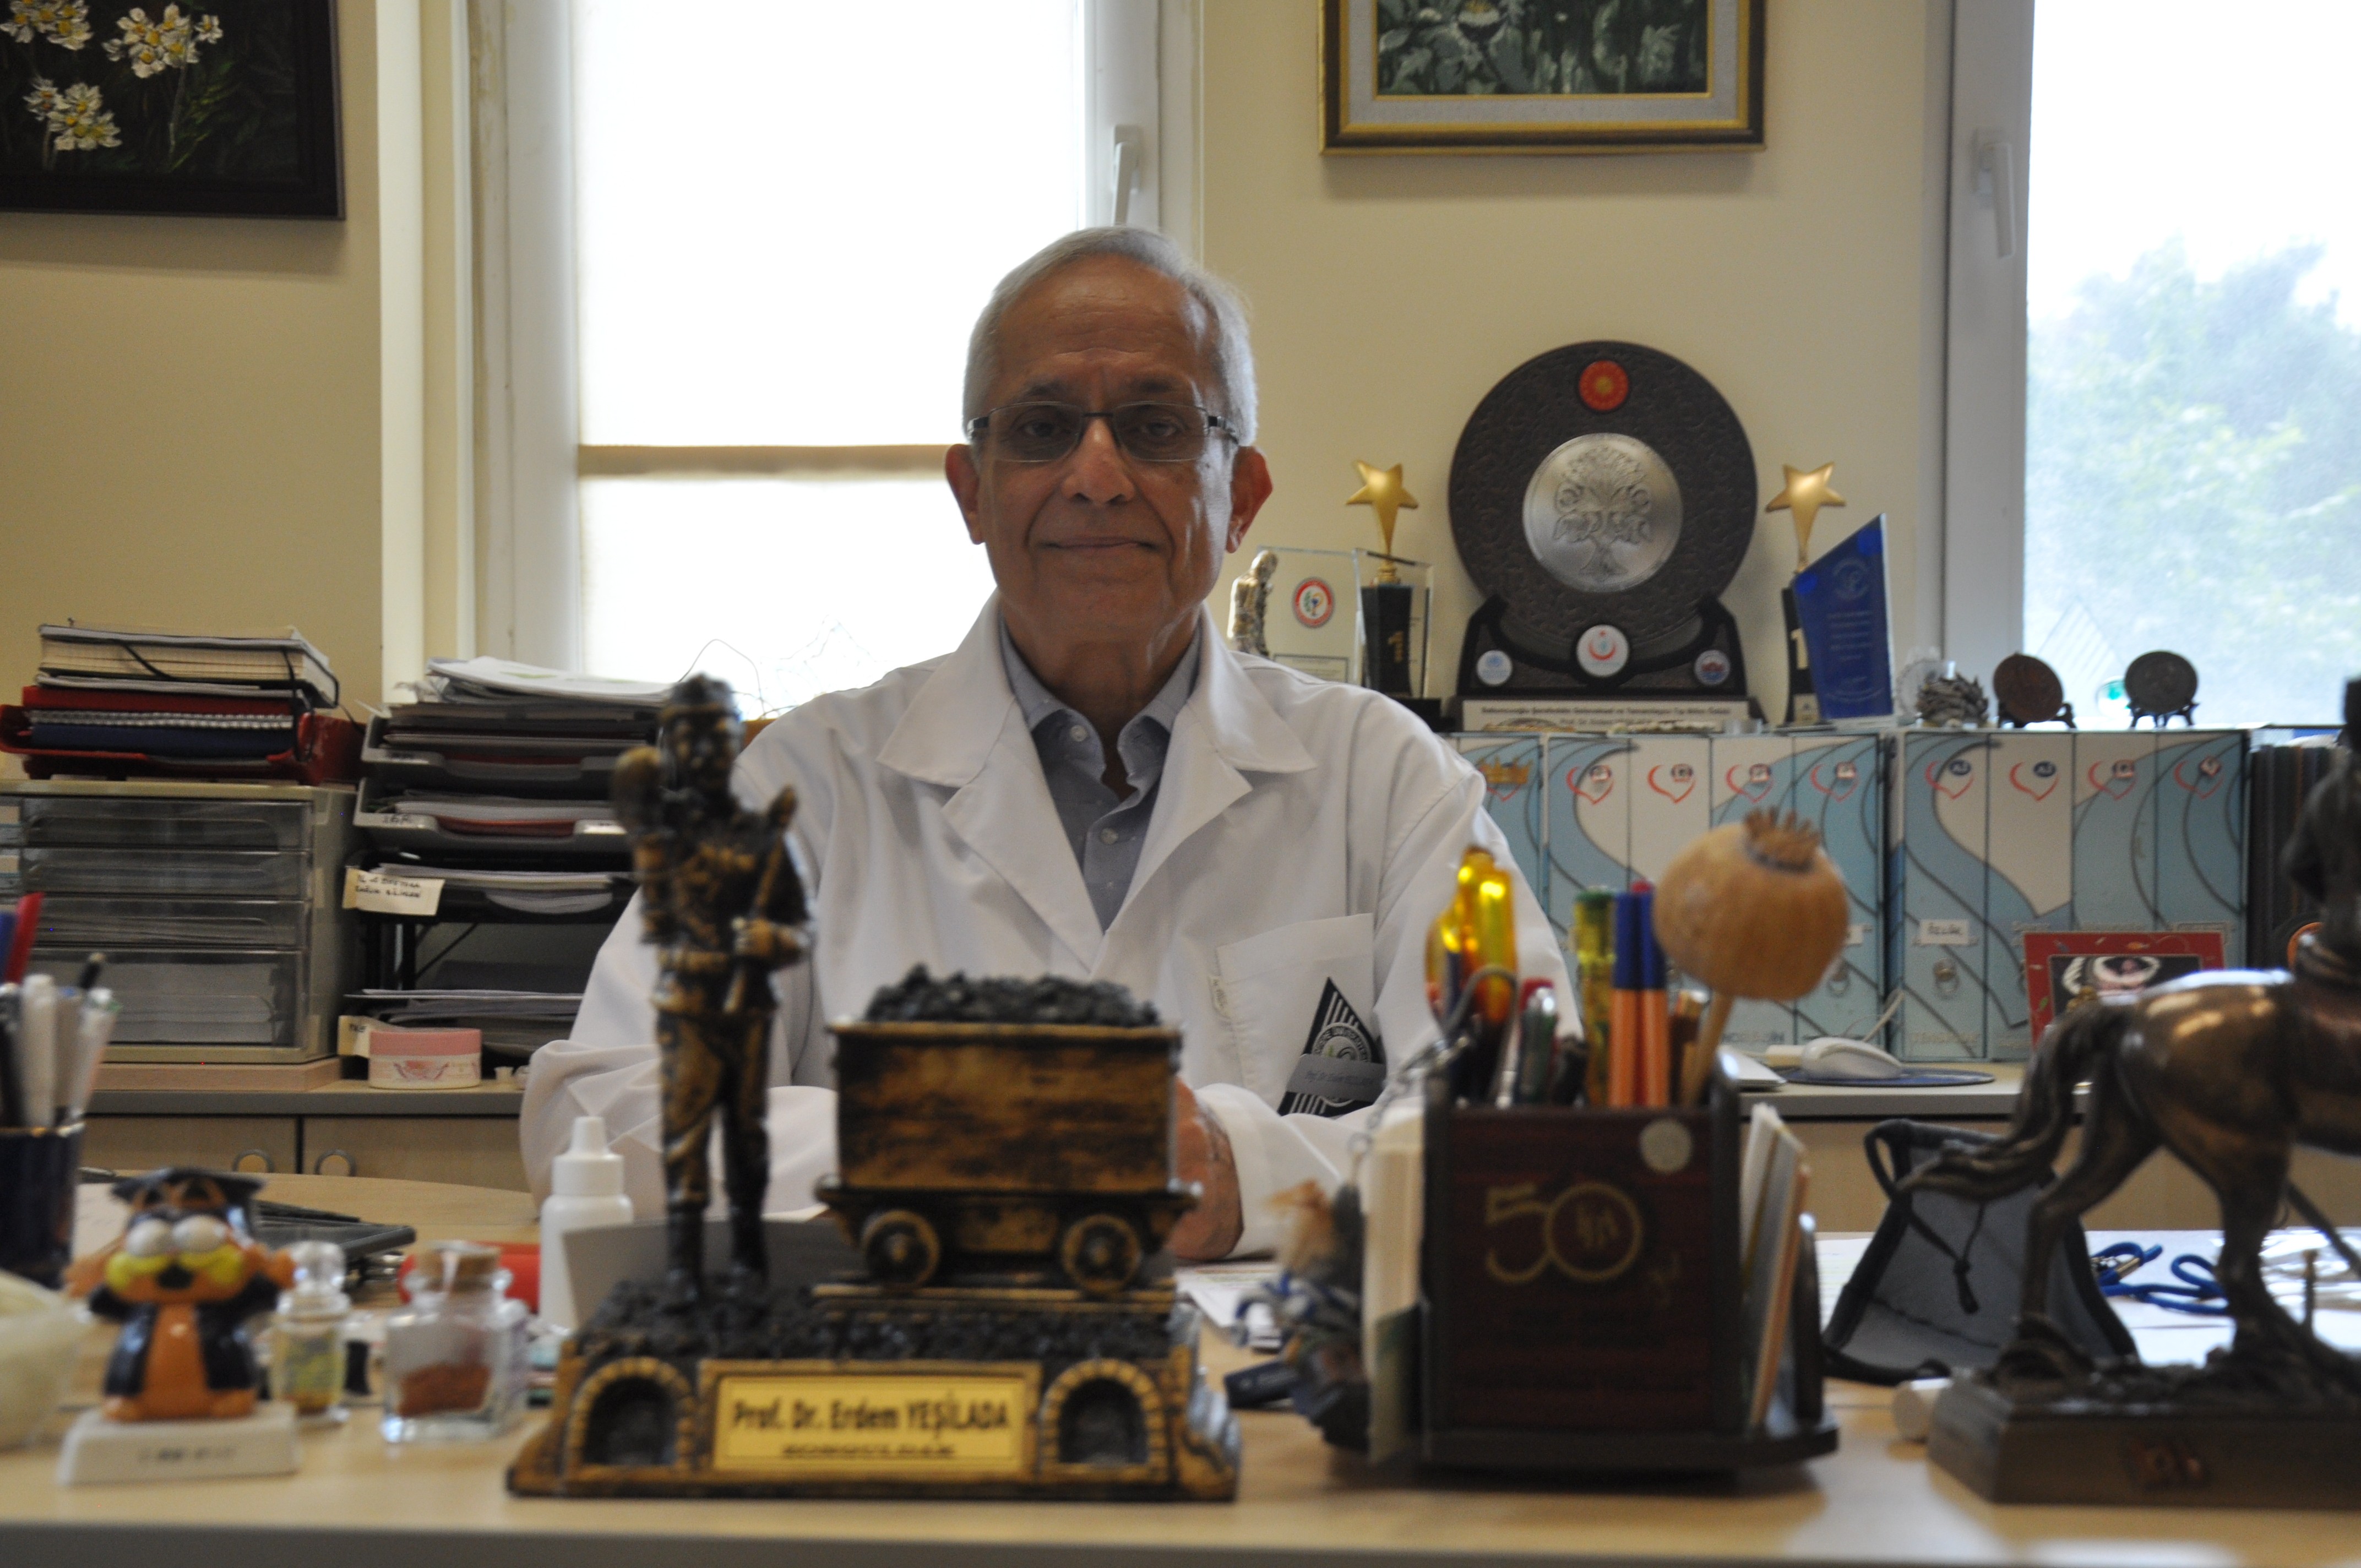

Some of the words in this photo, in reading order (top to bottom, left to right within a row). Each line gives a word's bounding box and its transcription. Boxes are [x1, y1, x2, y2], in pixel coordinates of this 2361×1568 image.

[1388, 631, 1405, 663] 1
[1791, 629, 1809, 670] 1
[1485, 1182, 1645, 1284] 50
[734, 1397, 785, 1429] Prof.
[792, 1398, 823, 1429] Dr.
[830, 1397, 899, 1429] Erdem
